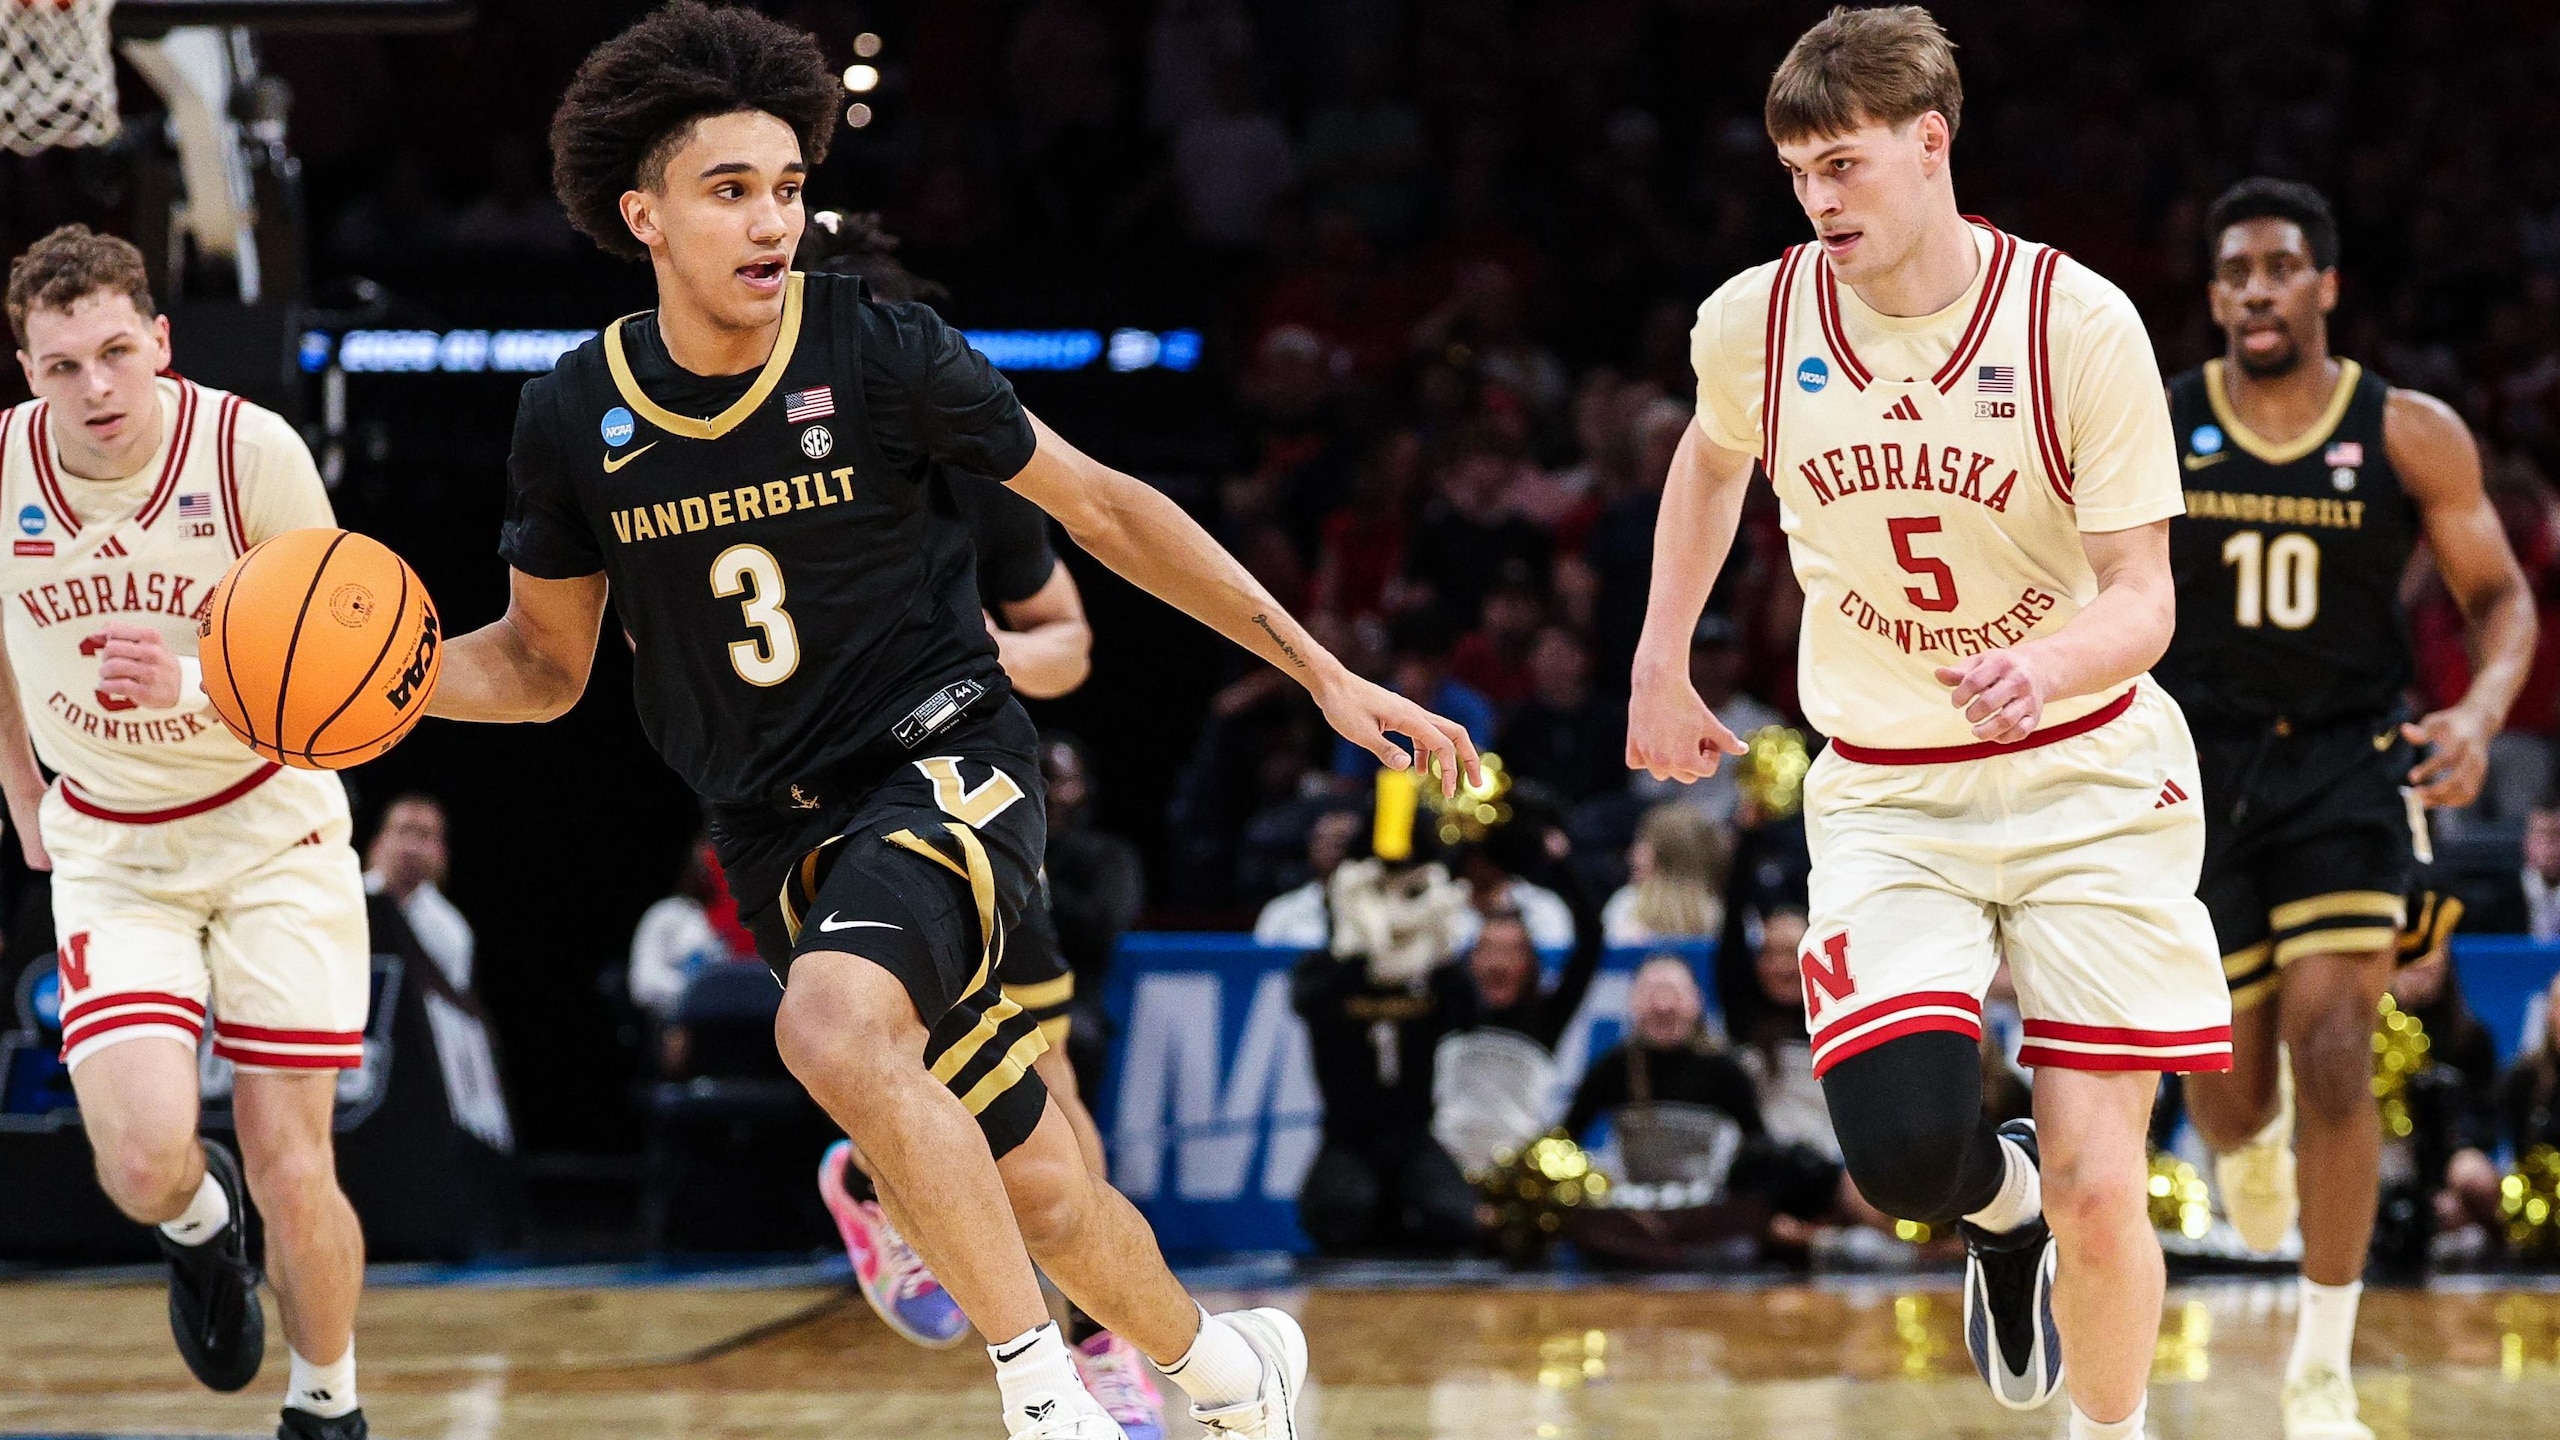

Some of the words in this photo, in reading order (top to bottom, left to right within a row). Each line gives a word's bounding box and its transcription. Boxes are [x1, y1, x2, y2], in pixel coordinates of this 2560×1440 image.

[1800, 371, 1827, 386] NCAA
[1974, 401, 2016, 418] B1G
[605, 424, 633, 438] NCAA
[803, 430, 832, 456] SEC
[611, 466, 855, 544] VANDERBILT
[1799, 443, 2019, 513] NEBRASKA
[2184, 490, 2367, 529] VANDERBILT
[1887, 516, 1960, 613] 5
[2221, 530, 2321, 631] 10
[709, 543, 800, 687] 3
[1840, 587, 2055, 656] CORNHUSKERS
[386, 600, 438, 712] NCAA
[48, 691, 221, 745] CORNHUSK
[955, 685, 971, 698] 44
[1800, 930, 1858, 1018] N
